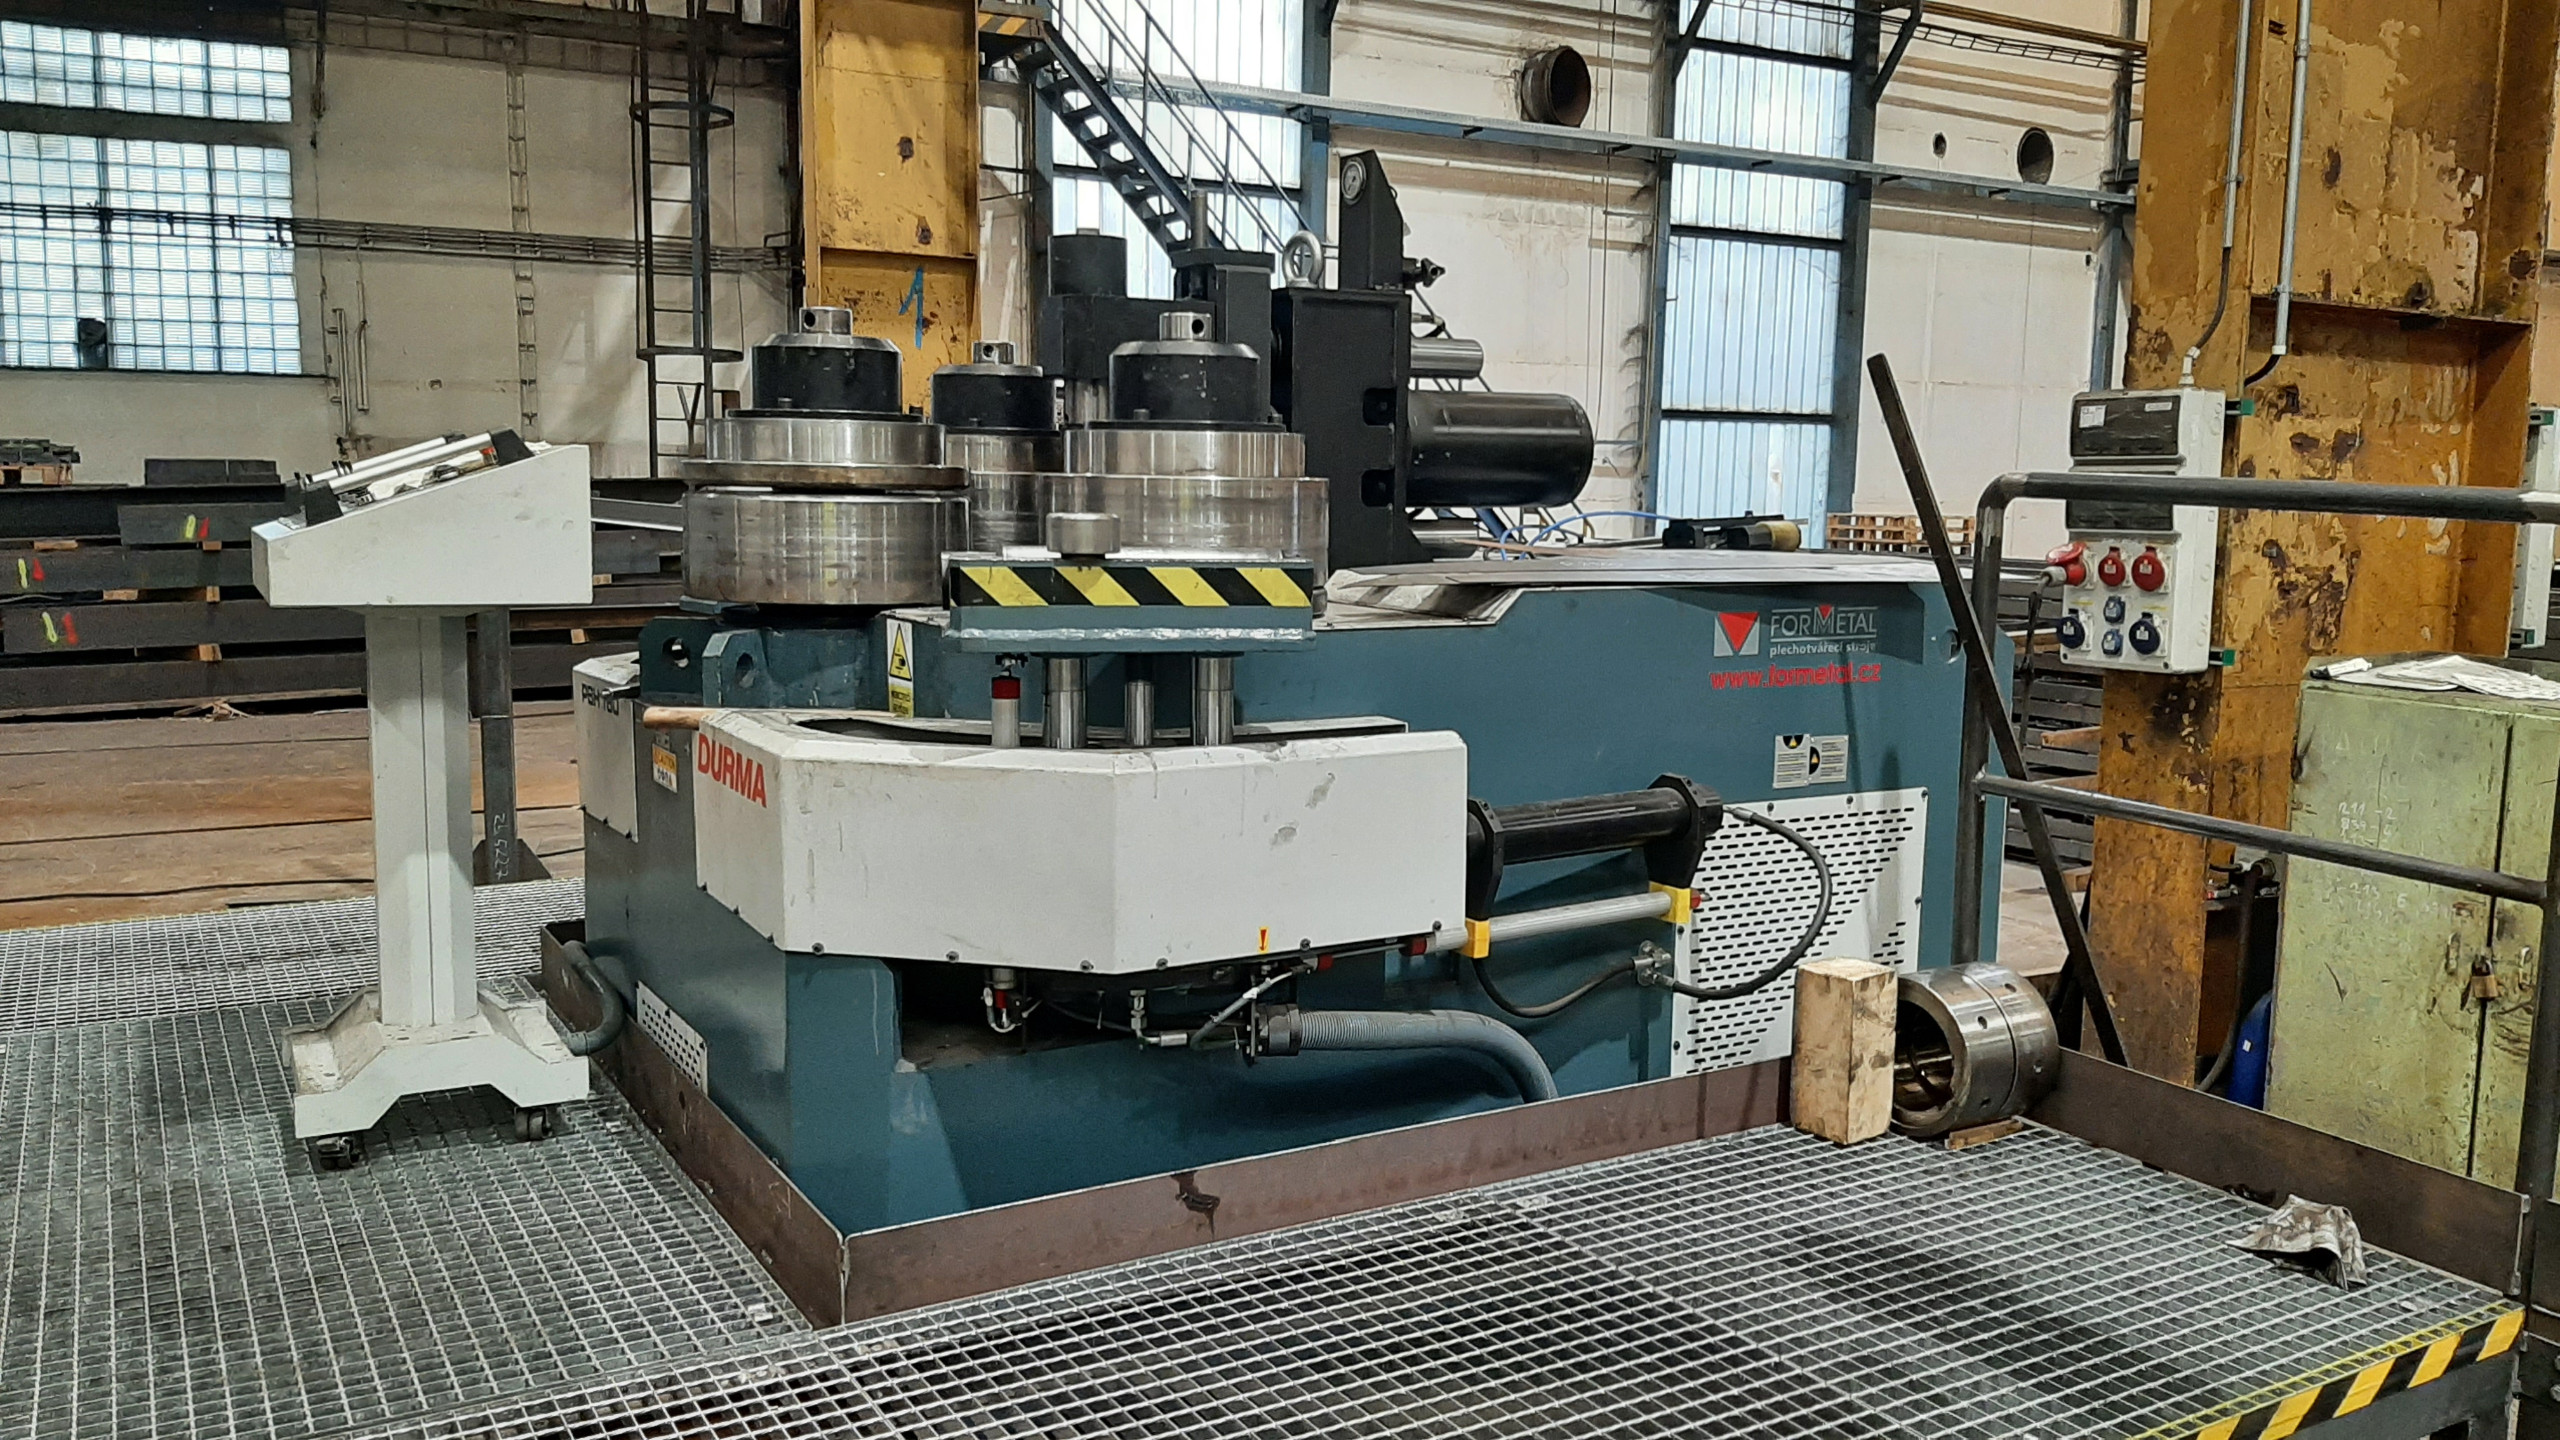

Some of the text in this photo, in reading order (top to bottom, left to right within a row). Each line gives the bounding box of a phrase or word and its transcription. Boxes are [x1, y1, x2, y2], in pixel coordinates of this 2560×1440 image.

[897, 266, 924, 350] 1
[1709, 662, 1882, 691] www.formetal.cz
[697, 734, 768, 808] DURMA
